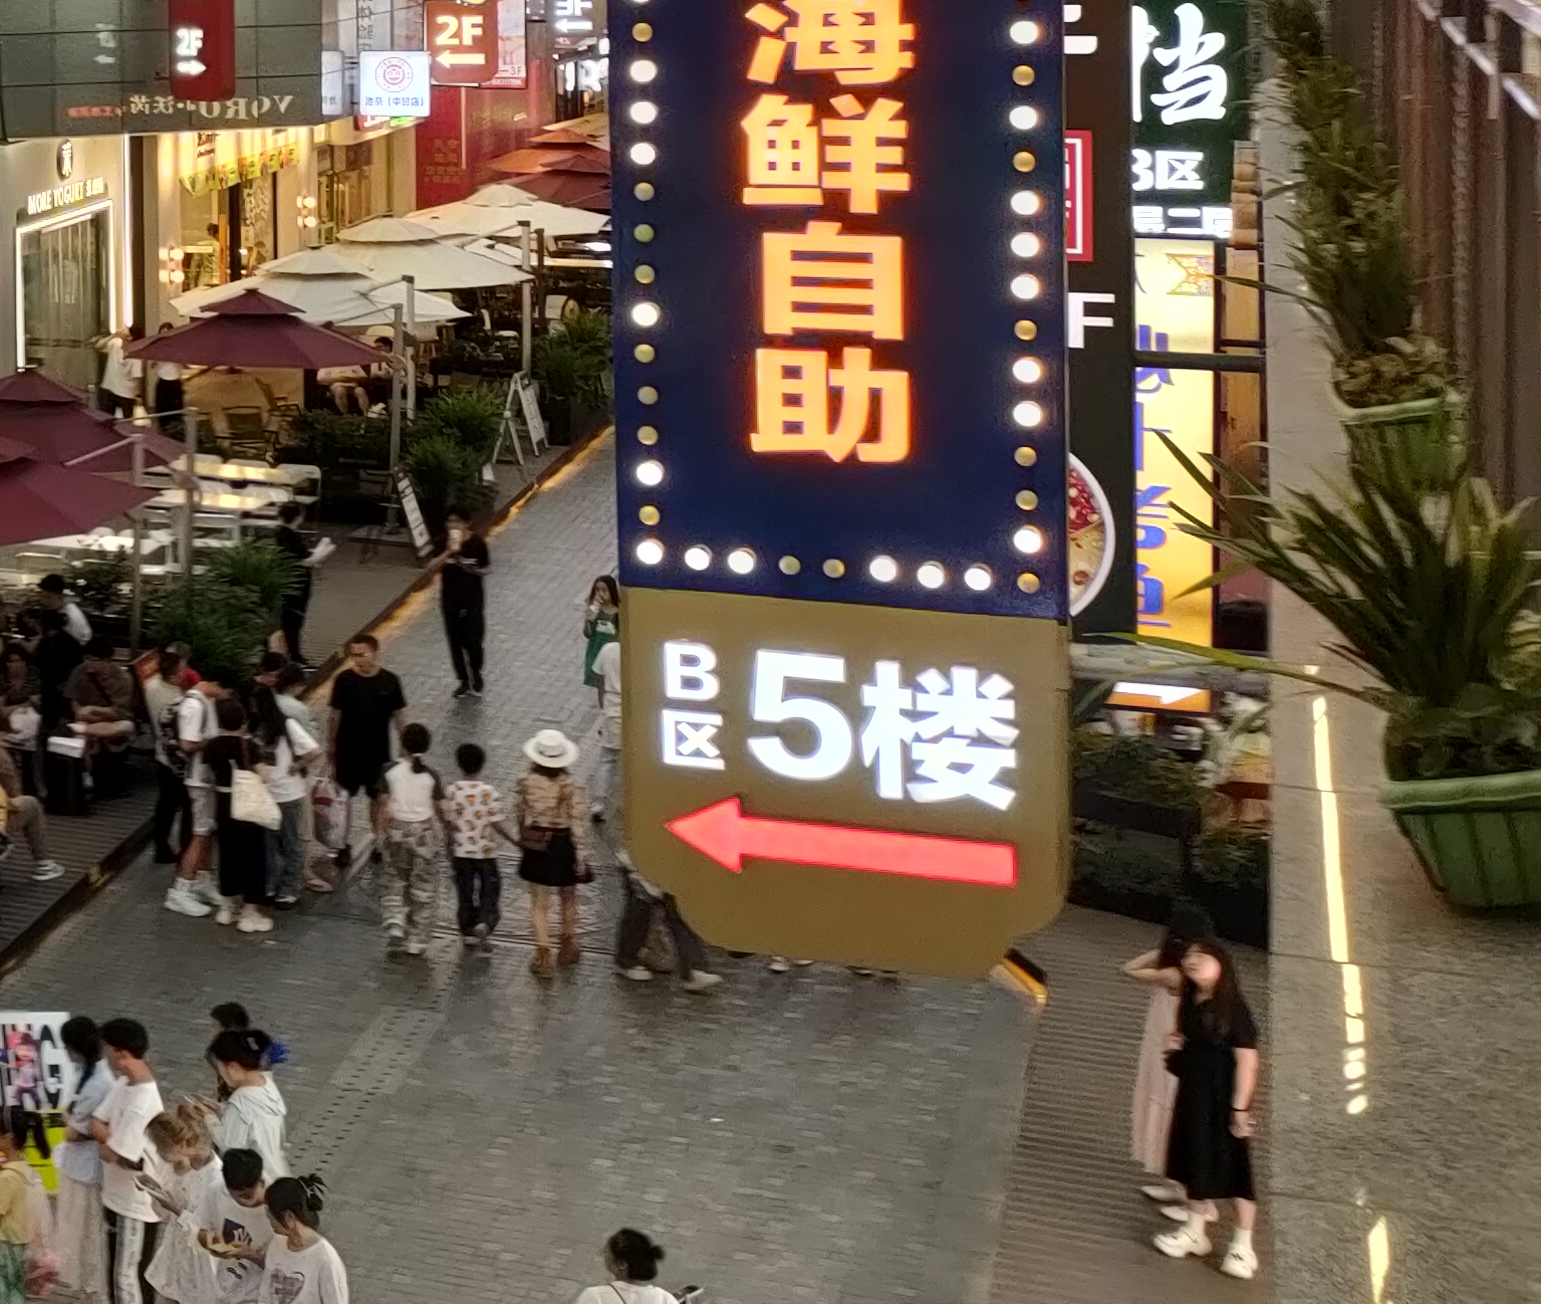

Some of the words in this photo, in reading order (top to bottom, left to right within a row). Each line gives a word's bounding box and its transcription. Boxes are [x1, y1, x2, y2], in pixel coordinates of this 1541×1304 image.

[175, 28, 204, 54] 2F
[436, 15, 484, 46] 2F
[747, 648, 1018, 810] 5楼
